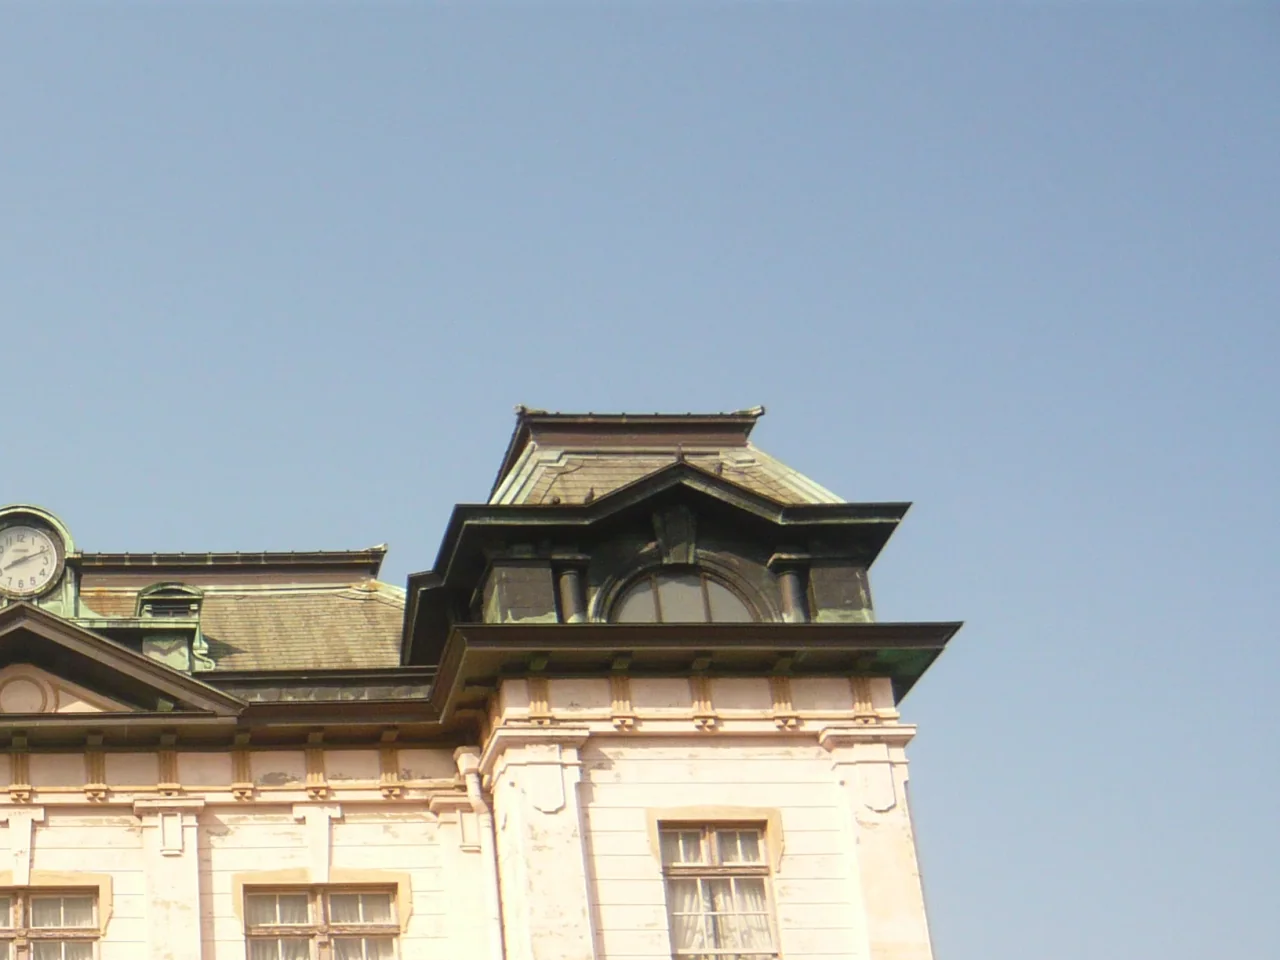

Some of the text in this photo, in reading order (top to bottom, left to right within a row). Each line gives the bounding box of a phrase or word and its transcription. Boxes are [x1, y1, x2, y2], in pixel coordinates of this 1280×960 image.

[5, 536, 12, 546] 11
[16, 534, 25, 543] 12
[42, 556, 48, 566] 3
[39, 568, 45, 576] 4
[7, 577, 12, 585] 7
[18, 579, 24, 588] 6
[30, 576, 36, 585] 5
